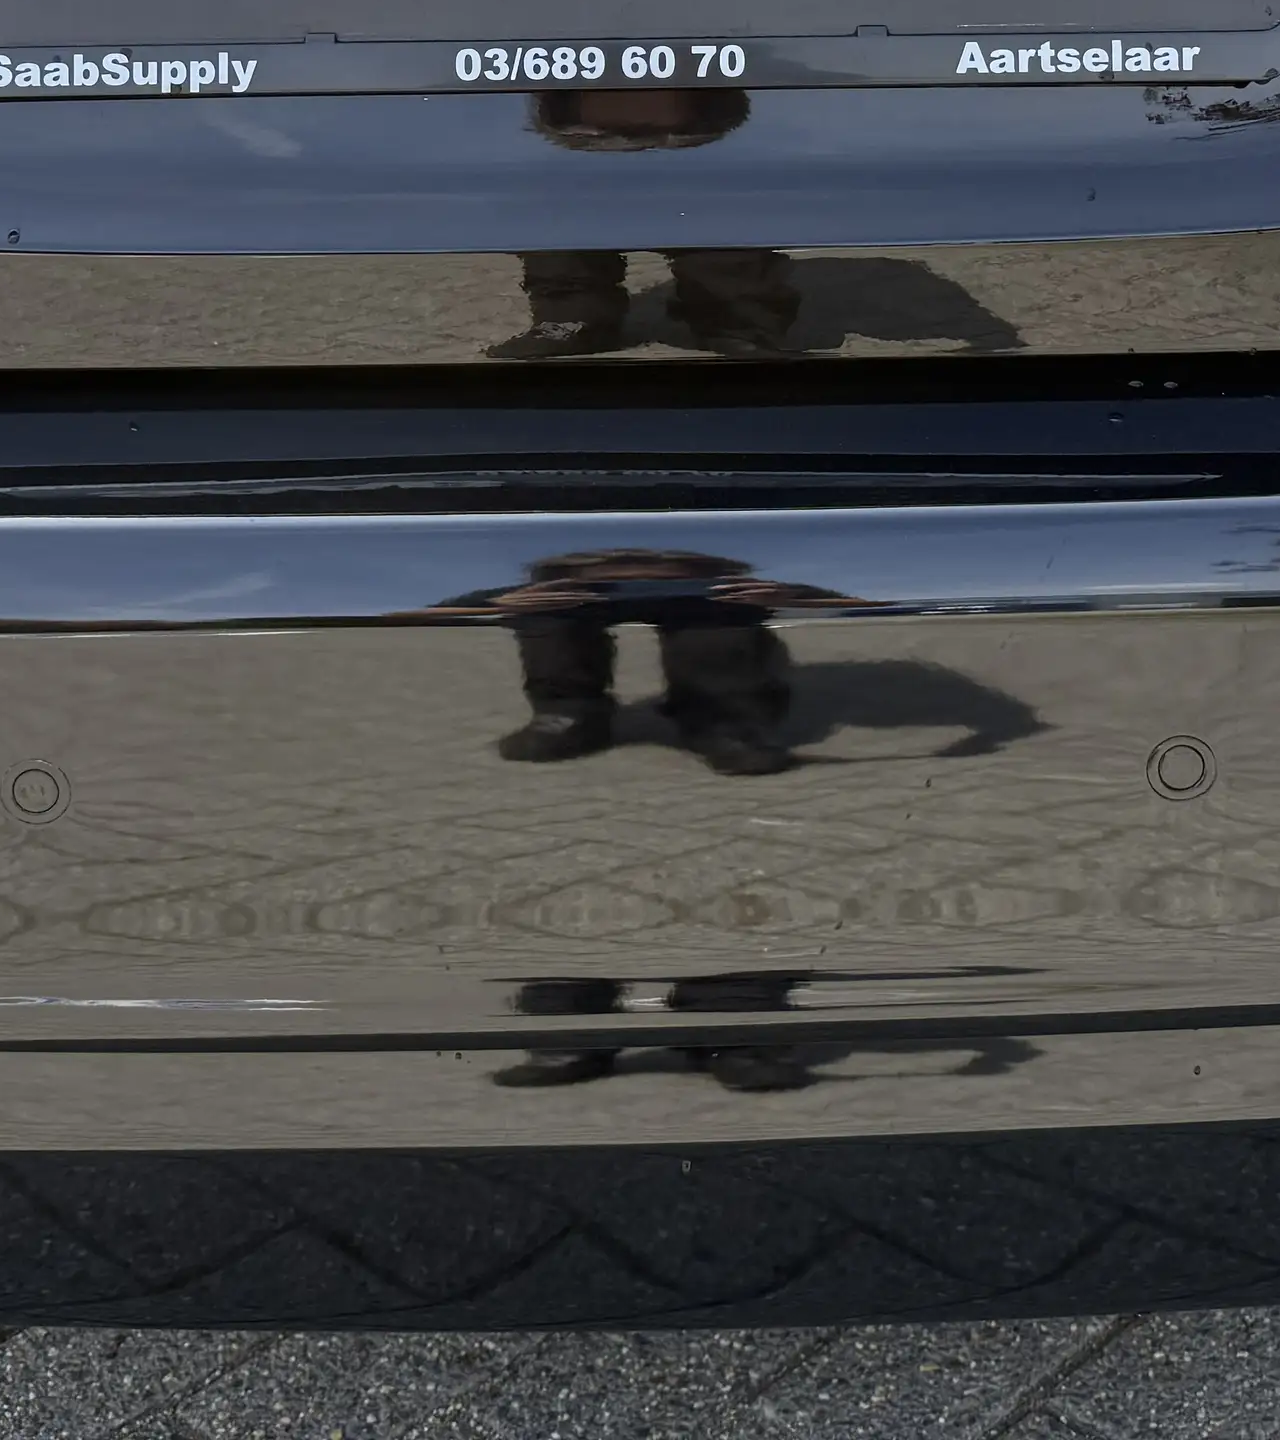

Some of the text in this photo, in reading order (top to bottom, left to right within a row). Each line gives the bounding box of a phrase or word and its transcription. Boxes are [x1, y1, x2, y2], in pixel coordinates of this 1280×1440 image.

[455, 44, 746, 82] 03/689 60 70
[955, 39, 1201, 74] Aartselaar
